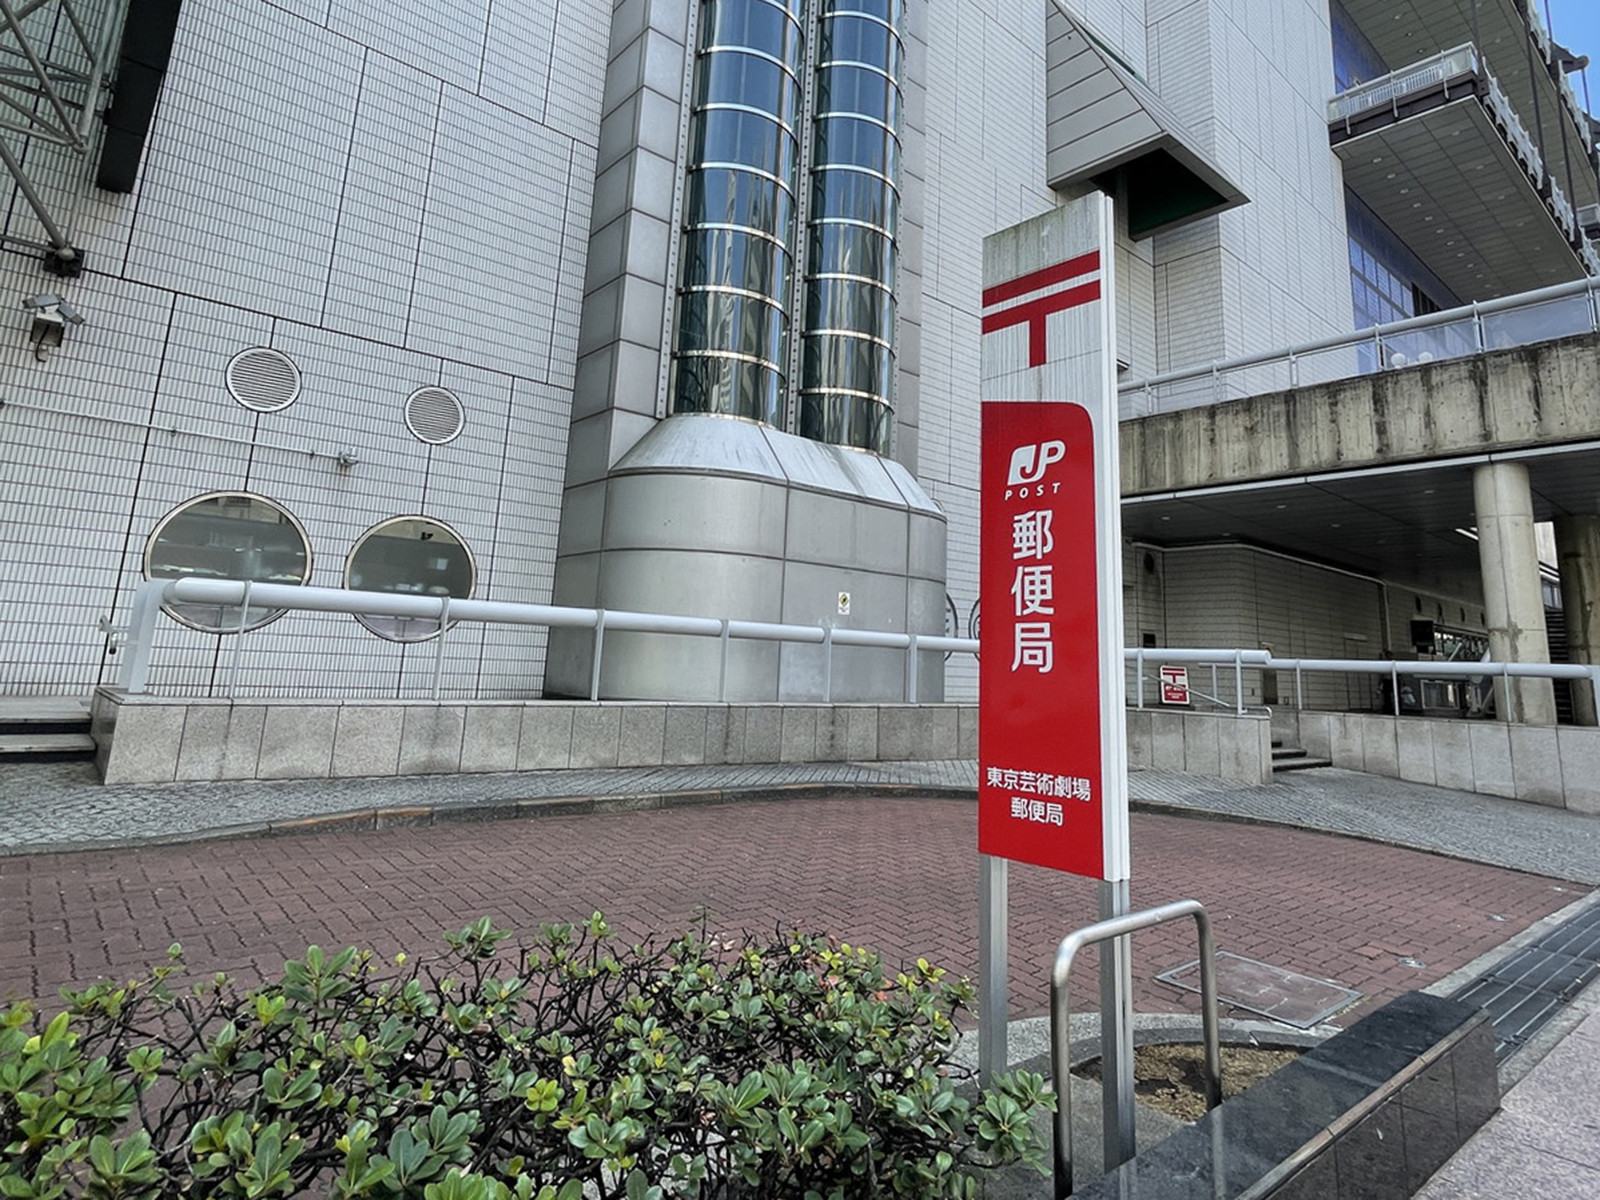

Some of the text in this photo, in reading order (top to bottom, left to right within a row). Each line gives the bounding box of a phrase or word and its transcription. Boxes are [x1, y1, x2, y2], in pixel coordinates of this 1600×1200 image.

[1007, 440, 1066, 486] JP
[1004, 482, 1061, 501] POST
[1011, 509, 1055, 674] 郵便局
[986, 766, 1092, 802] 東京芸術劇場
[1010, 796, 1064, 827] 郵便局
